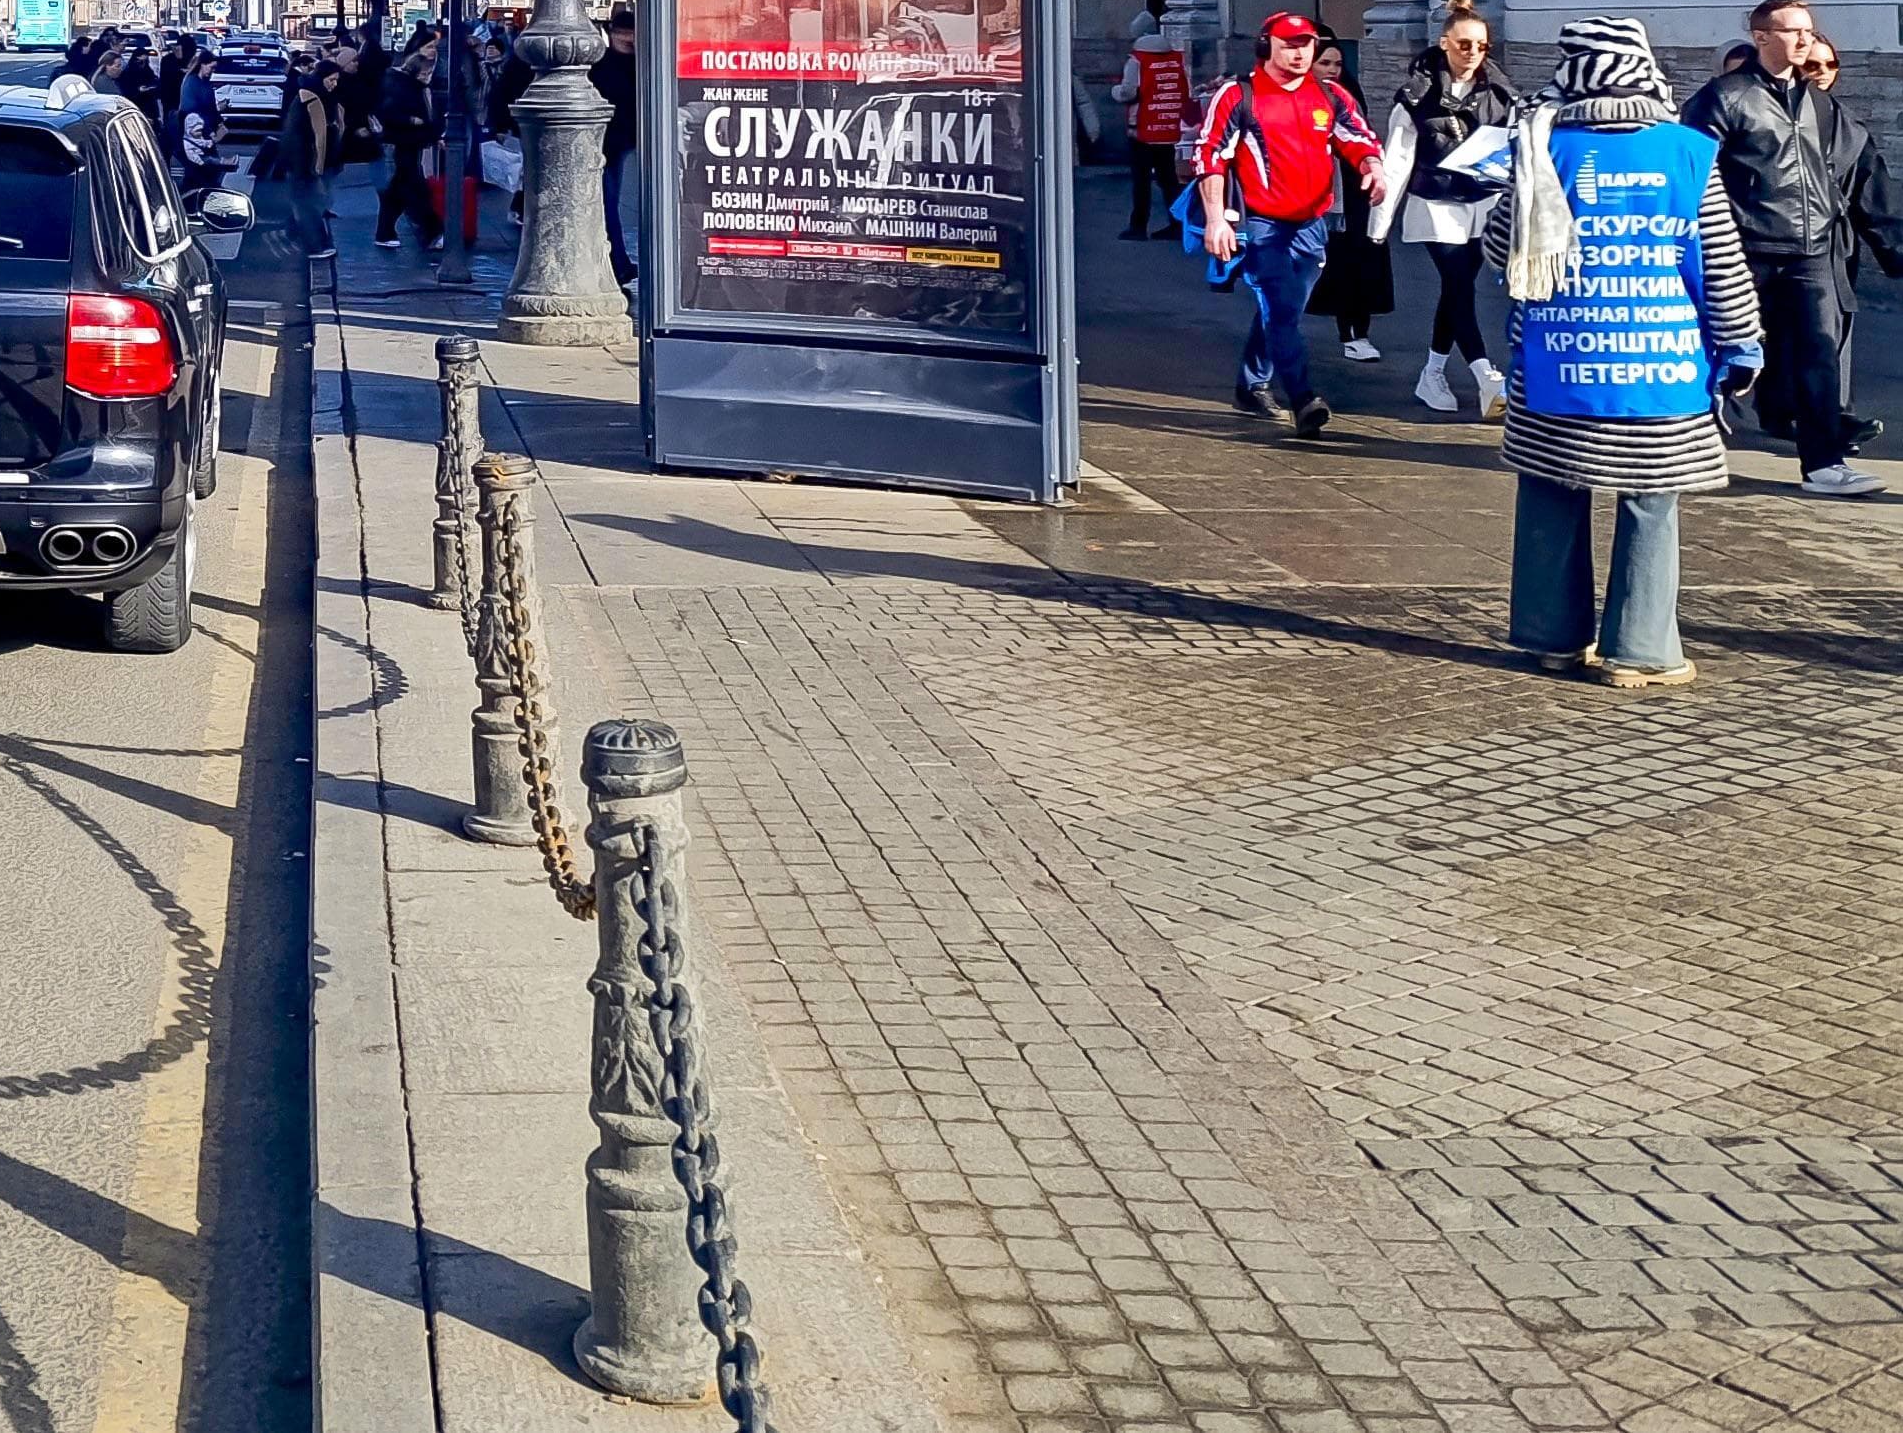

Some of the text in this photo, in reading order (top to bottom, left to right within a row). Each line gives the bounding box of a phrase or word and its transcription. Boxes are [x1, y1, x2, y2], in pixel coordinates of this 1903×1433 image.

[702, 51, 996, 73] ПОСТАНОВКА РОМАНА ВИКТЮКА
[702, 87, 769, 102] ЖАН ЖЕНЕ
[961, 89, 996, 107] 18+
[704, 106, 993, 165] СЛУЖАНКИ
[902, 171, 994, 194] РИТУАЛ
[1598, 172, 1667, 187] ПАРУС
[711, 192, 988, 220] БОЗИН Дмитрий МОТЫРЕВ Станислав
[702, 212, 998, 243] ПОЛОВЕНКО Михаил МАШНИН Валерий
[1574, 214, 1699, 240] СКУРСИИ
[1559, 360, 1698, 384] ПЕТЕРГОФ
